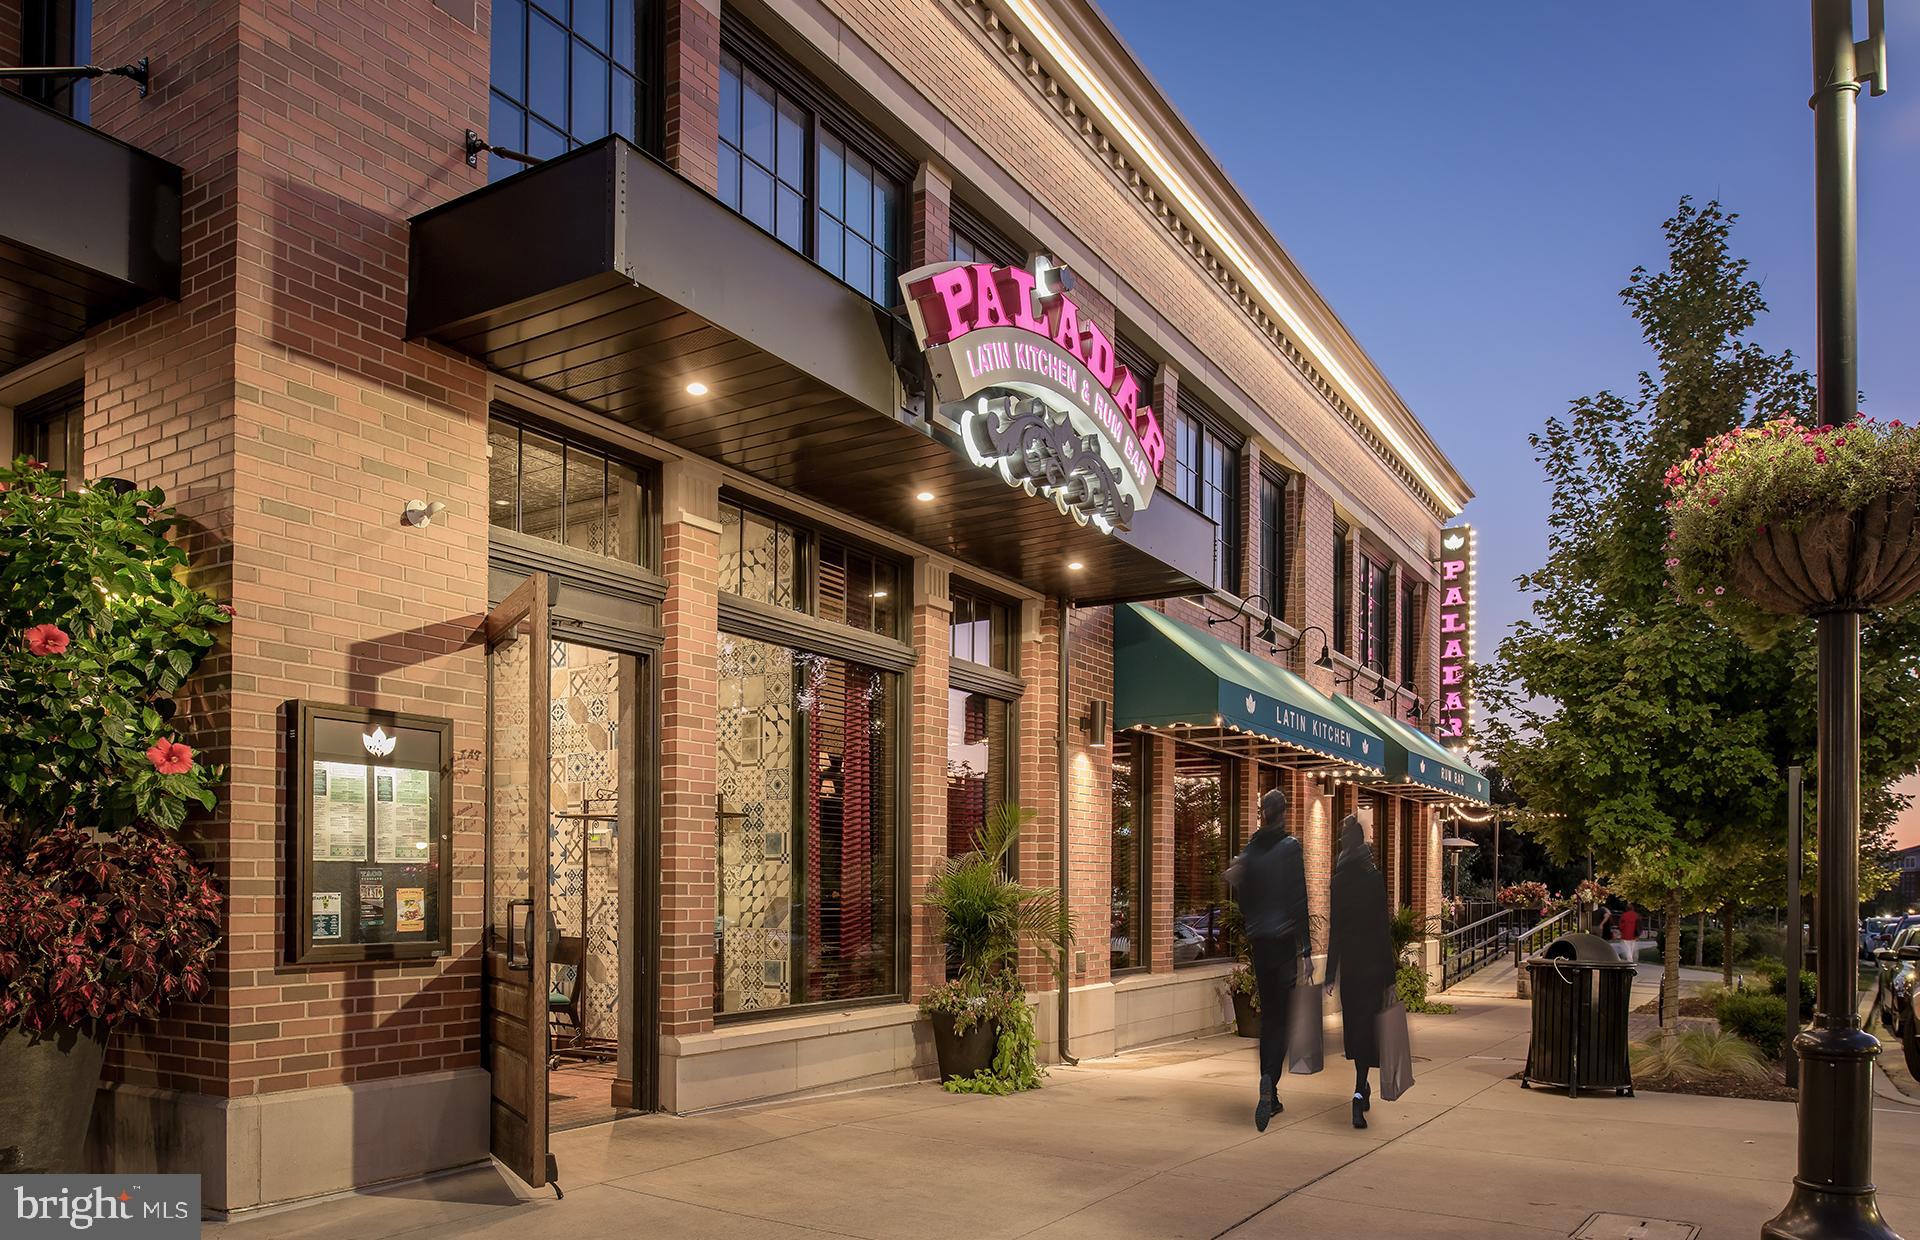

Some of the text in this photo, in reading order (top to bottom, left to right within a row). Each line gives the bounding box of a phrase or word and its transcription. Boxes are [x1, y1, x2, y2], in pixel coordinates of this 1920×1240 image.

[930, 263, 1166, 479] PALADAR
[966, 341, 1149, 486] LATIN KITCHEN & RUM BAR
[1441, 560, 1466, 737] PALADAR
[1276, 706, 1351, 748] LATIN KITCHEN
[1454, 771, 1465, 786] BAR
